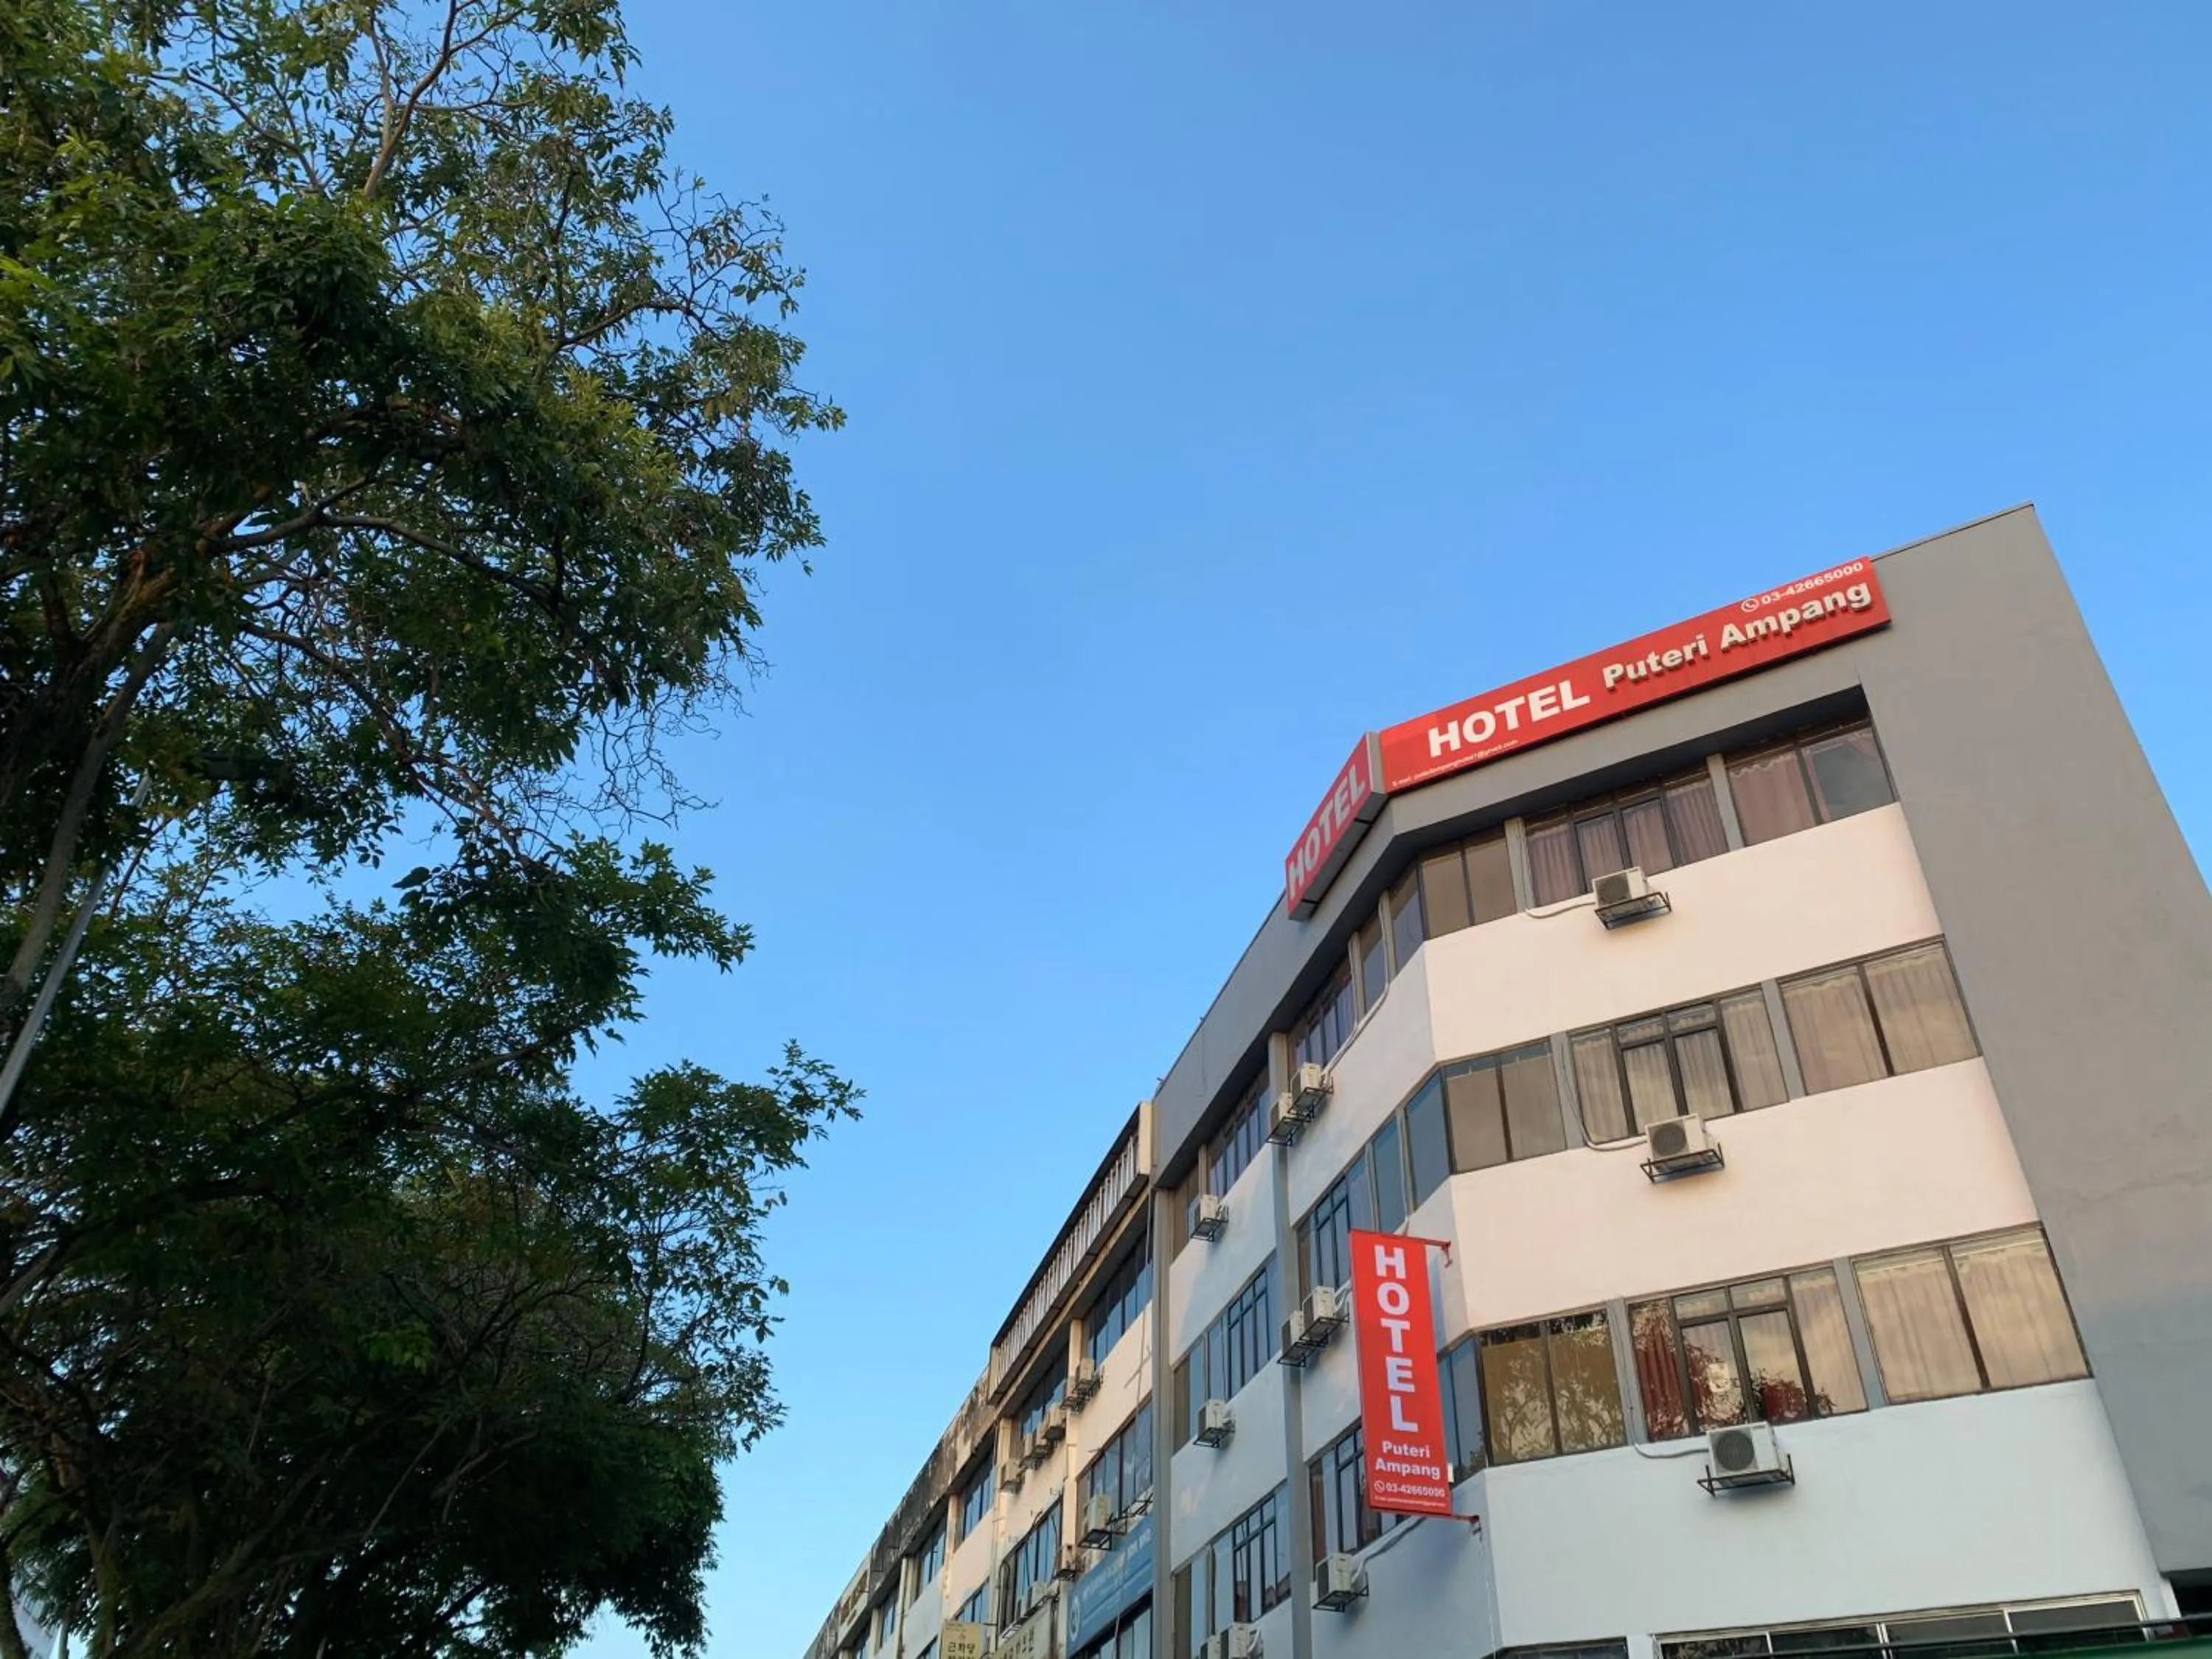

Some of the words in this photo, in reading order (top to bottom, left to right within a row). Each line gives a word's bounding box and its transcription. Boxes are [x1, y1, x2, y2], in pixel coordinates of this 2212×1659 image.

[1761, 561, 1863, 605] 03-42665000
[1427, 680, 1591, 758] HOTEL
[1602, 634, 1709, 689] Puteri
[1719, 582, 1873, 652] Ampang
[1289, 765, 1366, 900] HOTEL
[1374, 1244, 1419, 1433] HOTEL
[1374, 1457, 1441, 1481] Ampang
[1382, 1440, 1430, 1458] Puteri
